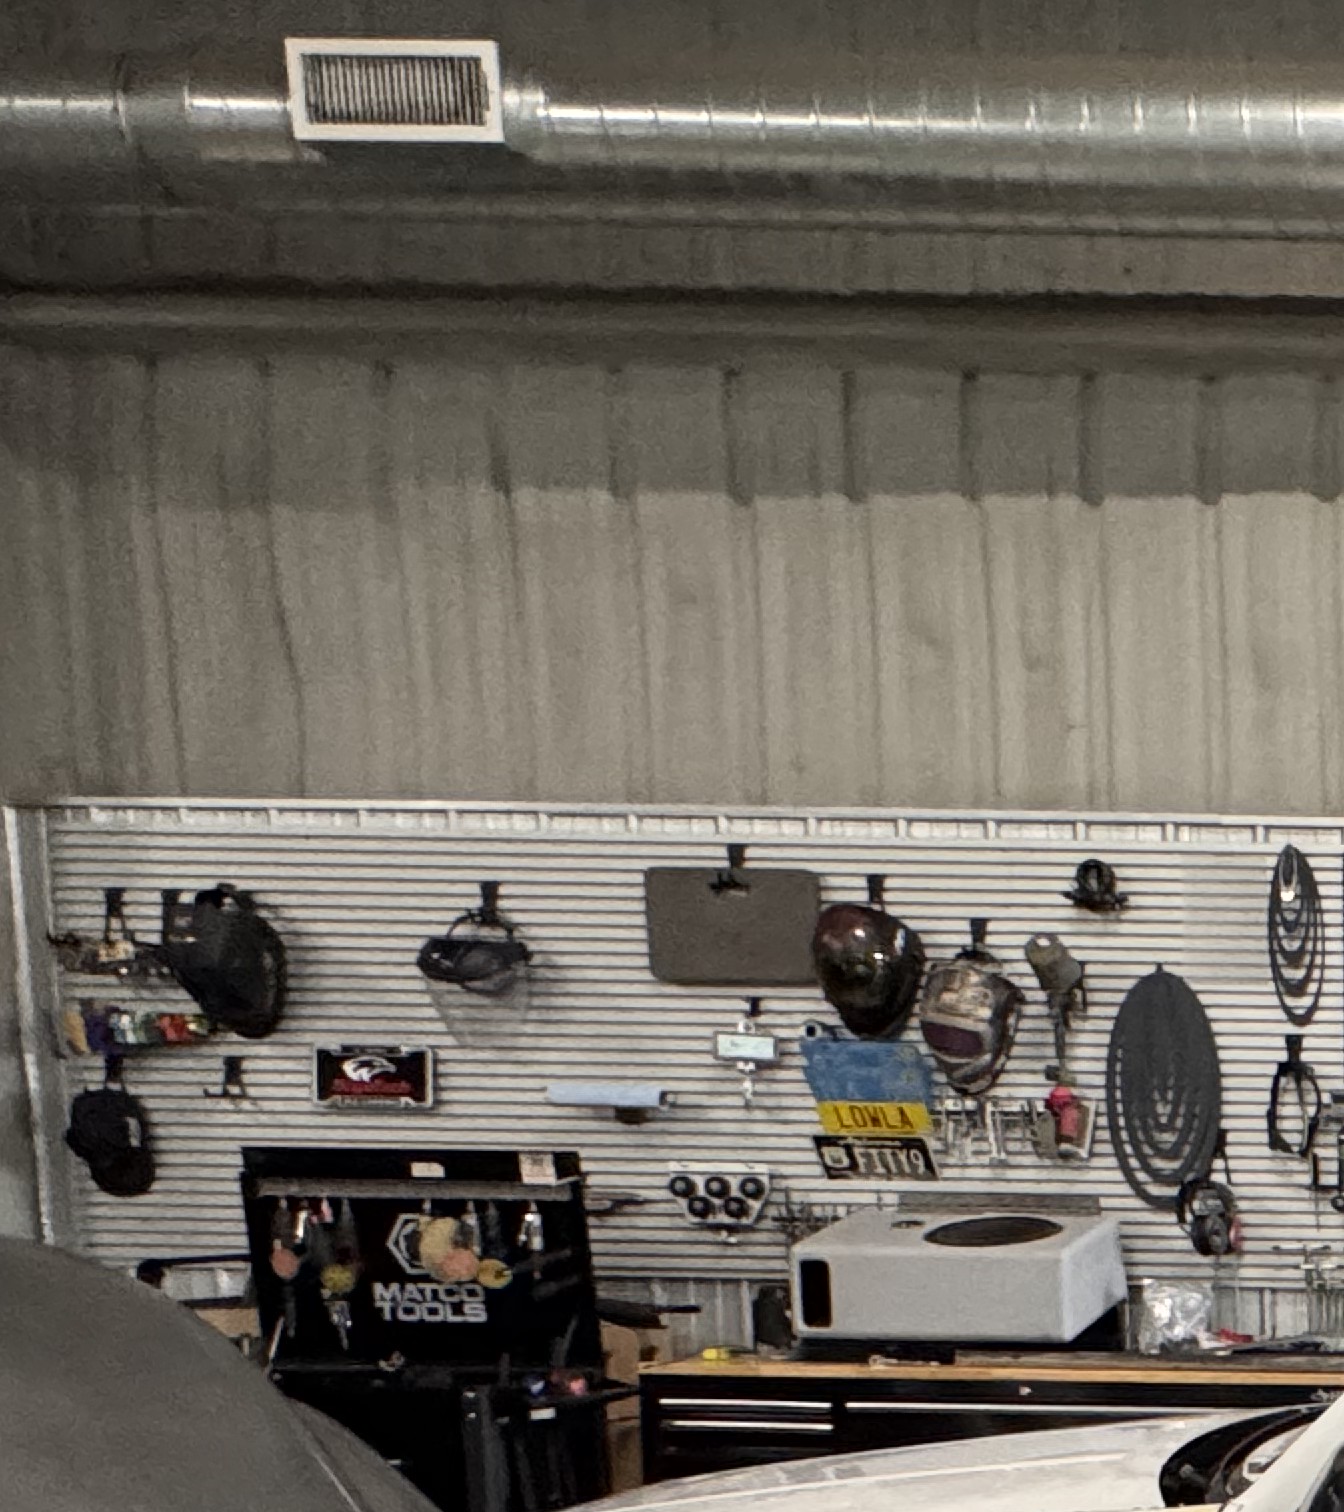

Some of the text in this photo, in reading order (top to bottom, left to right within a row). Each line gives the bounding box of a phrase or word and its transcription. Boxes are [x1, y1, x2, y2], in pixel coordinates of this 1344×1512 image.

[833, 1104, 914, 1130] LOWLA
[373, 1282, 486, 1302] MATCO
[374, 1301, 488, 1322] TOOLS
